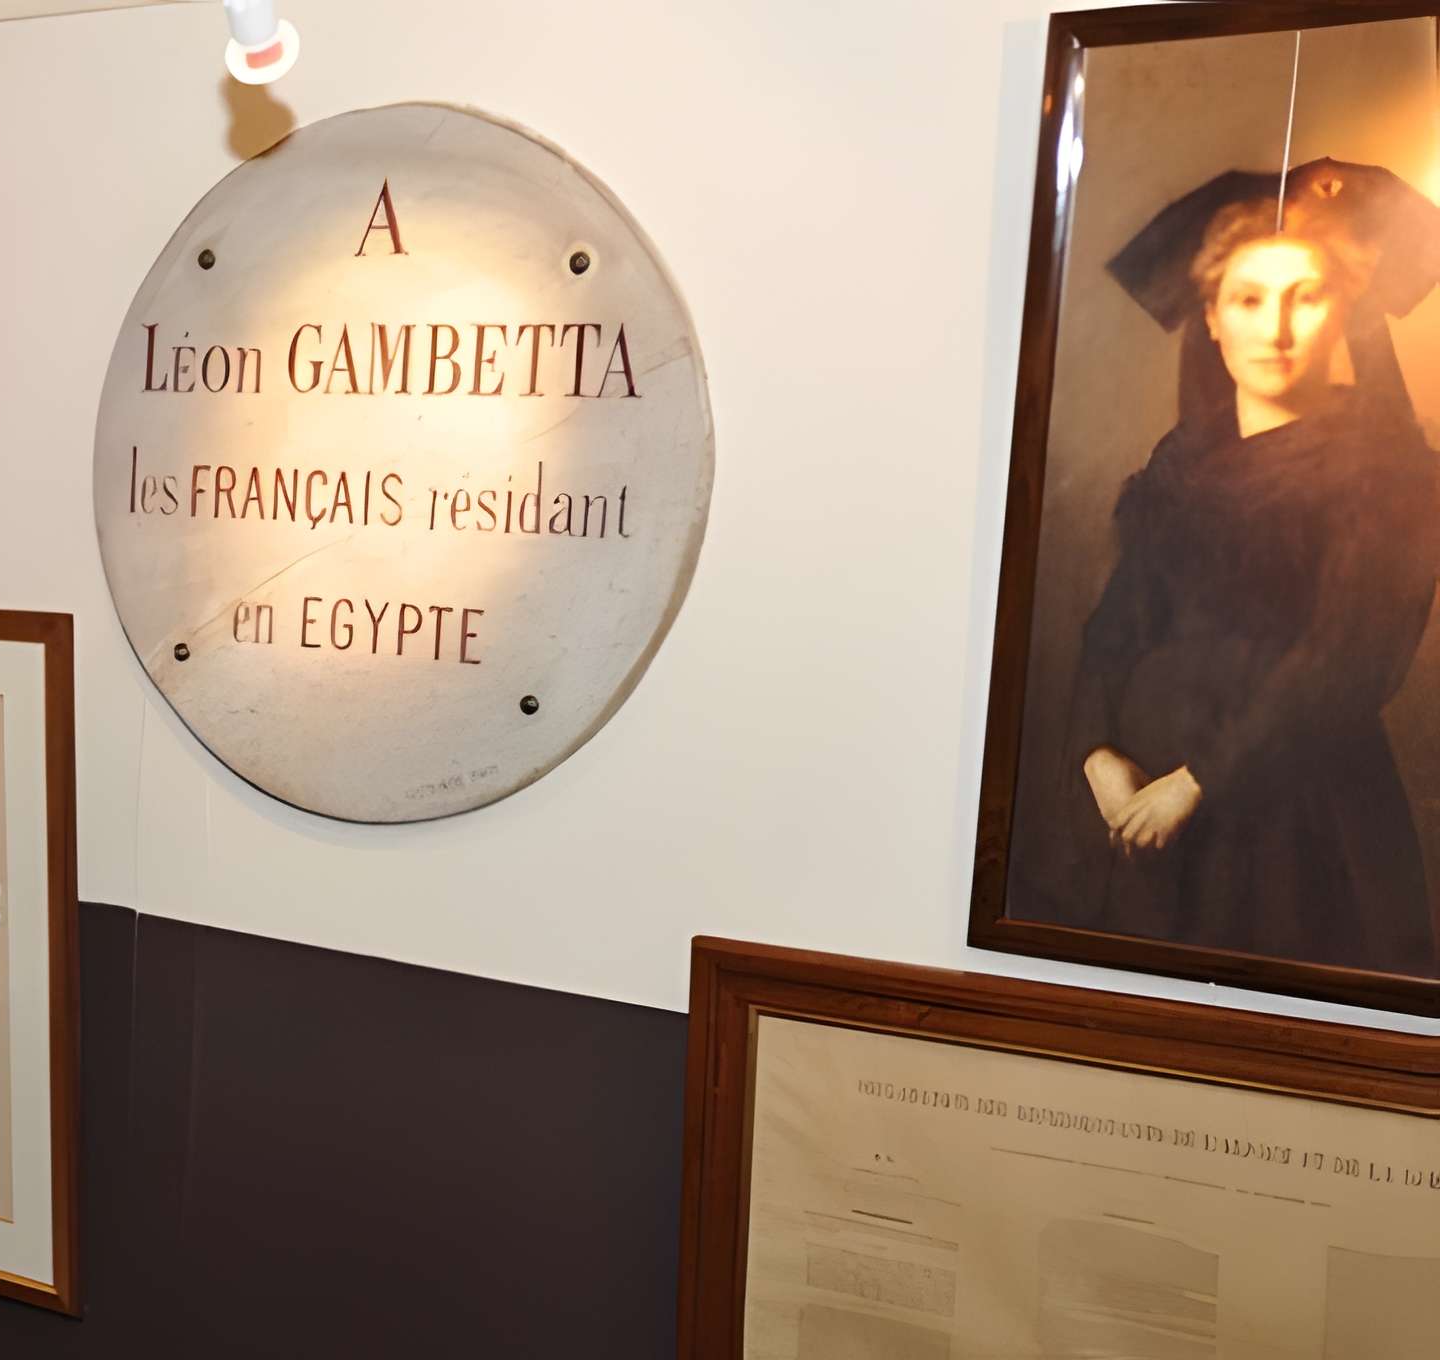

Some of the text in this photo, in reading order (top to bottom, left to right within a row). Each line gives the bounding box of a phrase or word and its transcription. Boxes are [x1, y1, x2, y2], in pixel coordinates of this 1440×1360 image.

[355, 178, 408, 257] A
[287, 322, 642, 400] GAMBETTA
[129, 445, 632, 539] les FRANÇAIS résidant
[233, 596, 485, 665] en EGYPTE
